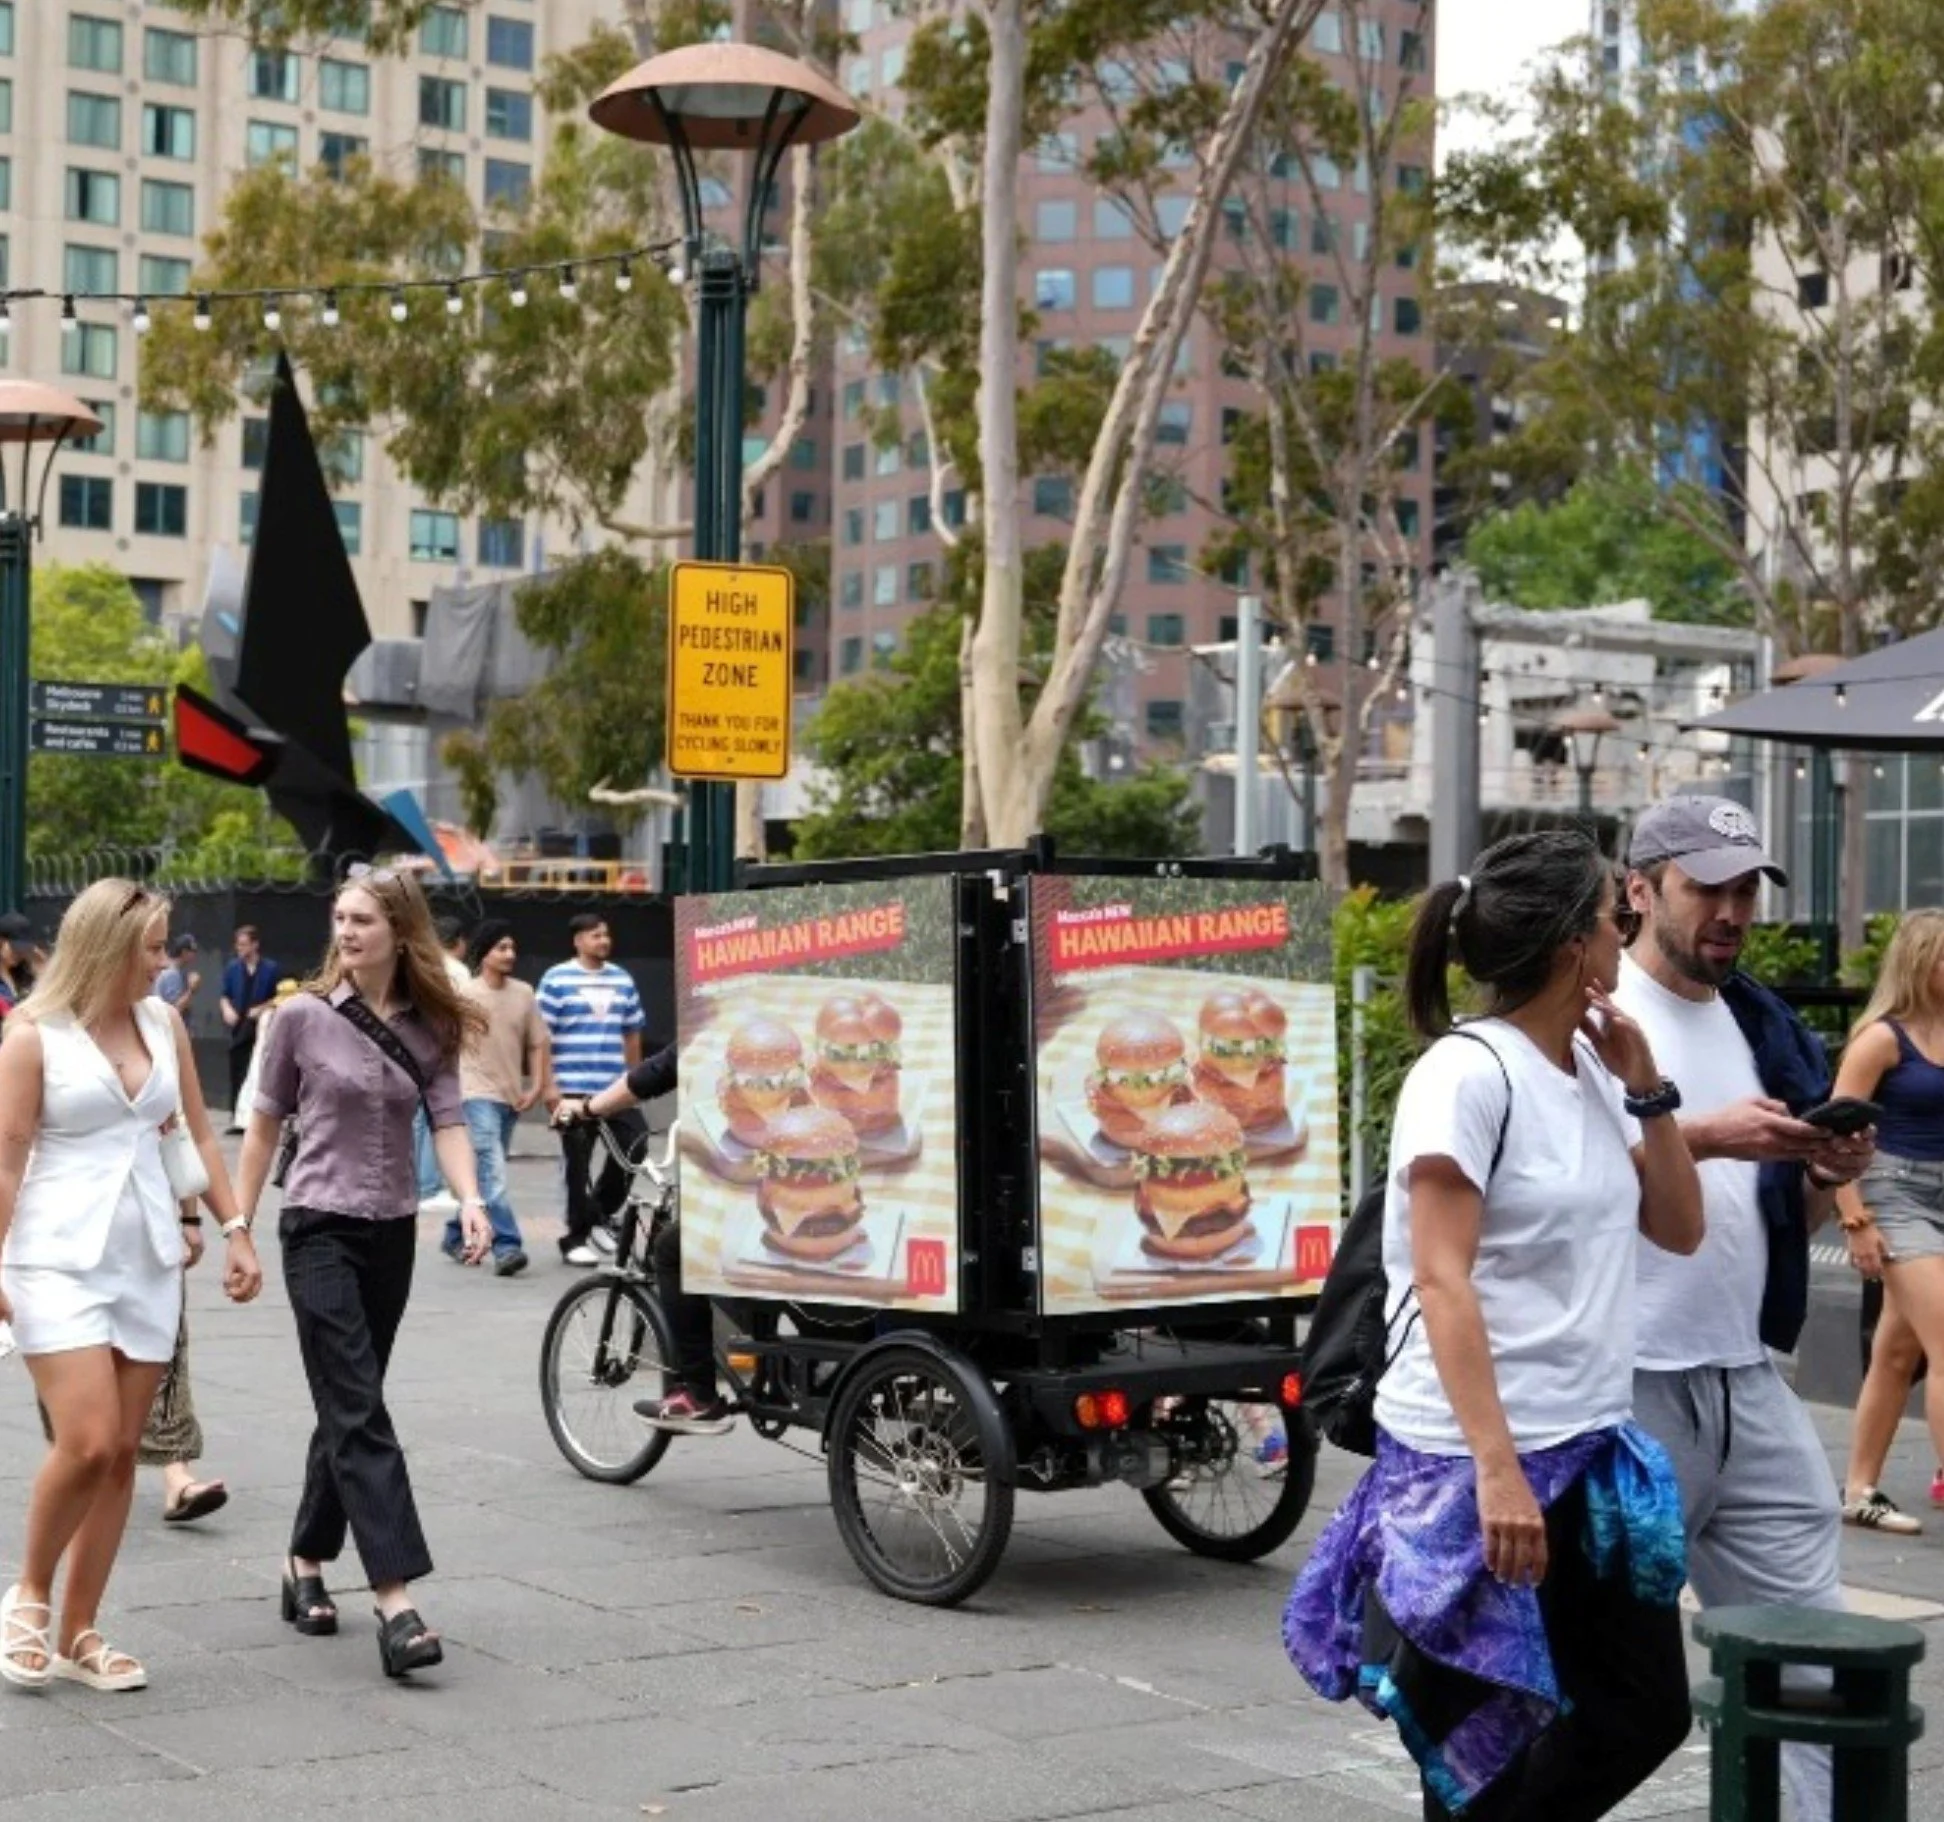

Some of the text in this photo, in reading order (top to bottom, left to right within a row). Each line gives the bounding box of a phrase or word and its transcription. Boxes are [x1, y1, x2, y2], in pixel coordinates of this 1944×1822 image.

[706, 590, 757, 616] HIGH
[679, 624, 782, 652] PEDESTRIAN
[703, 662, 758, 688] ZONE
[680, 712, 779, 732] THANK YOU FOR
[677, 734, 780, 755] CYCLING SLOWLY
[697, 902, 905, 970] HAWAIIAN RANGE
[1059, 904, 1288, 958] HAWAIIAN RANGE
